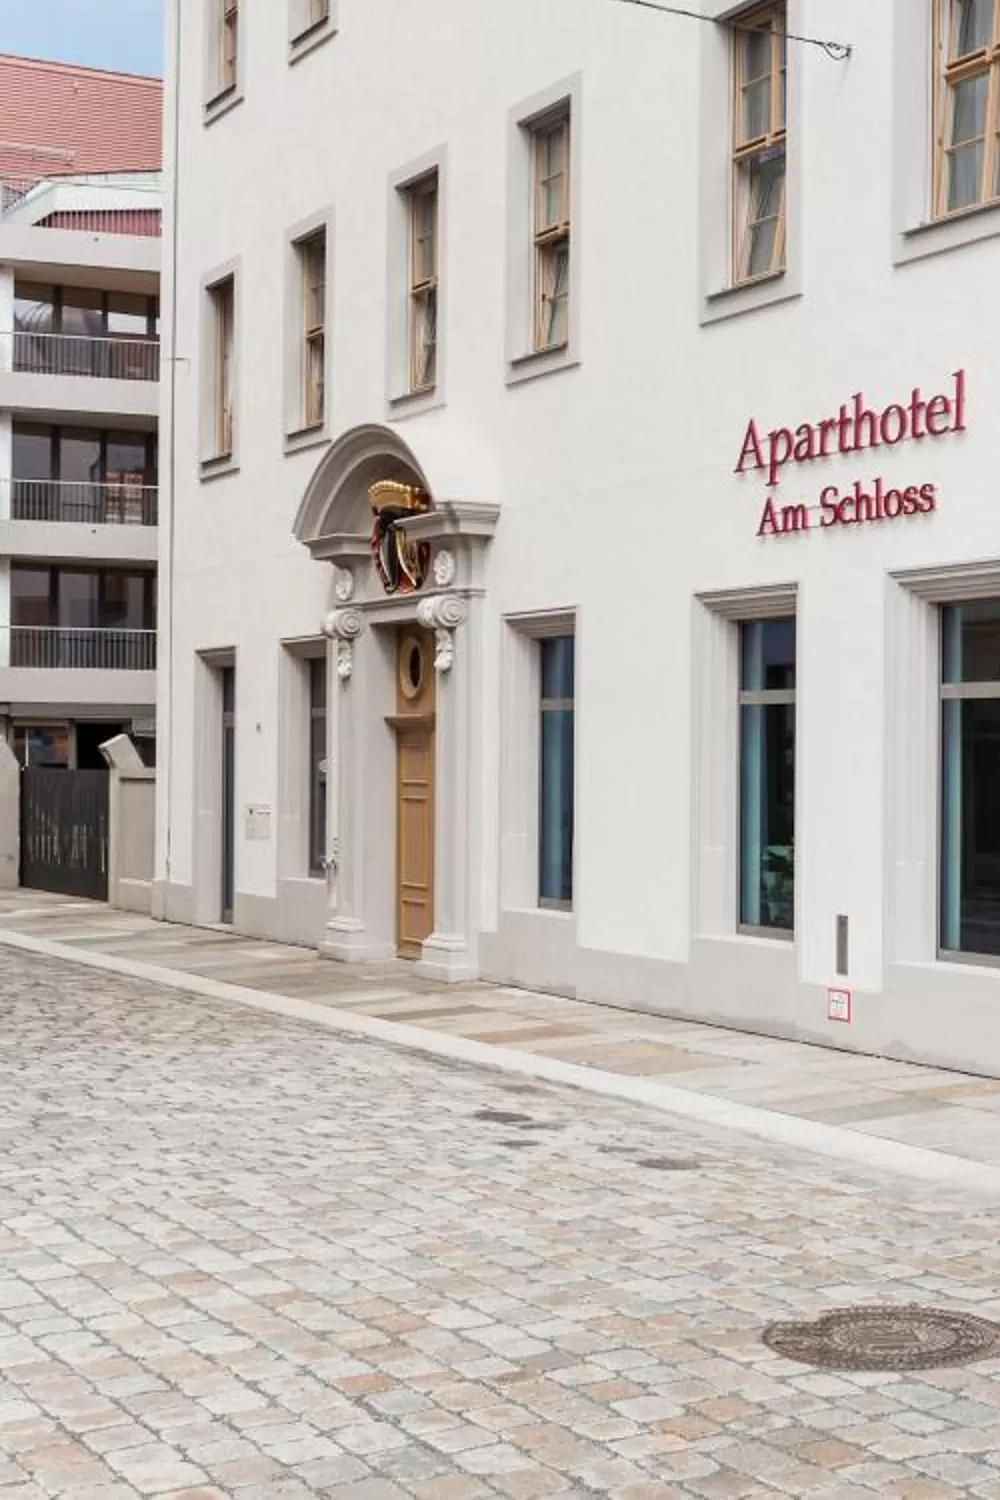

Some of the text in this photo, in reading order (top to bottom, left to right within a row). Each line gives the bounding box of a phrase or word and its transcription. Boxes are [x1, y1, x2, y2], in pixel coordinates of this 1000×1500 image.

[733, 369, 967, 487] Aparthotel
[756, 477, 937, 537] Am Schloss
